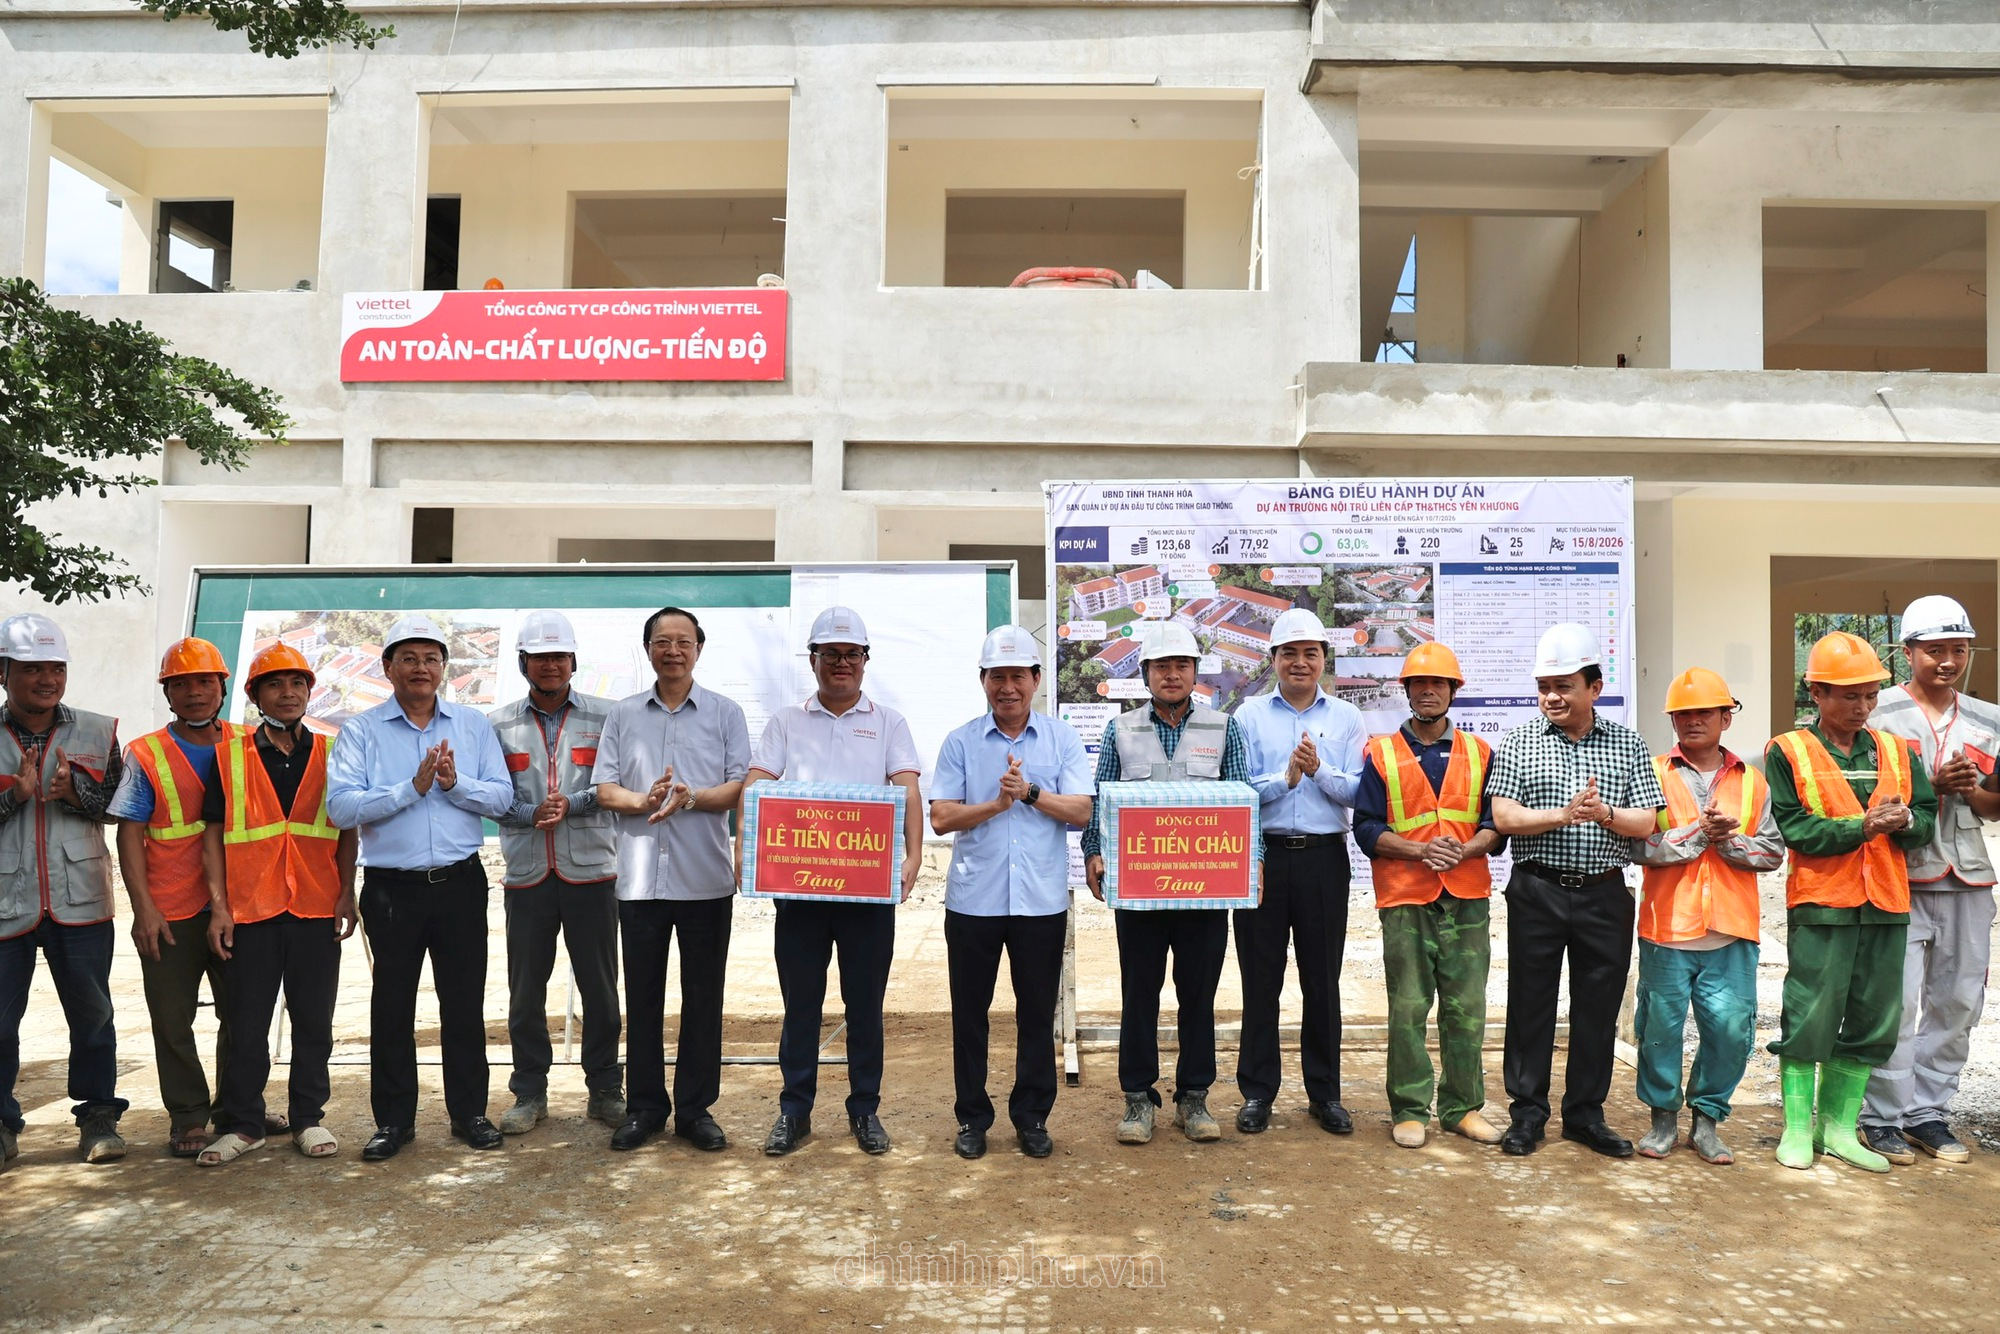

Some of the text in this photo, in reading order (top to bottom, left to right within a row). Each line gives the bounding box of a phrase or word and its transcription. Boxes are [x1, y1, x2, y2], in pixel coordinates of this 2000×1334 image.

[355, 299, 411, 310] viettel
[484, 299, 762, 316] TỔNG CÔNG TY CP CÔNG TRÌNH VIETTEL
[358, 326, 767, 365] AN TOÀN-CHẤT LƯỢNG-TIẾN ĐỘ
[1126, 488, 1144, 498] TỈNH
[1147, 490, 1174, 498] THANH
[1177, 489, 1193, 498] HÓA
[1288, 482, 1485, 501] BẢNG ĐIỀU HÀNH DỰ ÁN
[1066, 503, 1079, 511] BAN
[1081, 502, 1099, 511] QUẢN
[1101, 502, 1108, 511] LÝ
[1110, 503, 1119, 512] DỰ
[1121, 502, 1129, 511] ÁN
[1132, 502, 1144, 511] ĐẦU
[1156, 502, 1173, 510] CÔNG
[1176, 502, 1194, 510] TRÌNH
[1213, 501, 1233, 510] THÔNG
[1257, 500, 1519, 514] DỰ ÁN TRƯỜNG NỘI TRÚ LIÊN CẤP TH&THCS YÊN KHƯƠNG
[1361, 514, 1374, 523] CẬP
[1375, 514, 1393, 523] NHẬT
[1393, 514, 1406, 522] ĐẾN
[1407, 514, 1424, 522] NGÀY
[1059, 538, 1097, 550] KPI DỰ ÁN
[1156, 539, 1191, 552] 123,68
[1240, 539, 1269, 551] 77,92
[1337, 538, 1369, 551] 63,0%
[1420, 537, 1440, 548] 220
[1510, 537, 1523, 548] 25
[1572, 537, 1624, 548] 15/8/2026
[853, 729, 877, 737] viettel
[1480, 722, 1499, 732] 220
[1190, 747, 1219, 755] viettel
[837, 809, 861, 821] CHÍ
[1195, 813, 1218, 826] CHÍ
[766, 822, 886, 852] LÊ TIẾN CHÂU
[1127, 828, 1244, 854] LÊ TIẾN CHÂU
[793, 870, 846, 892] Tặng
[1154, 875, 1206, 895] Tặng
